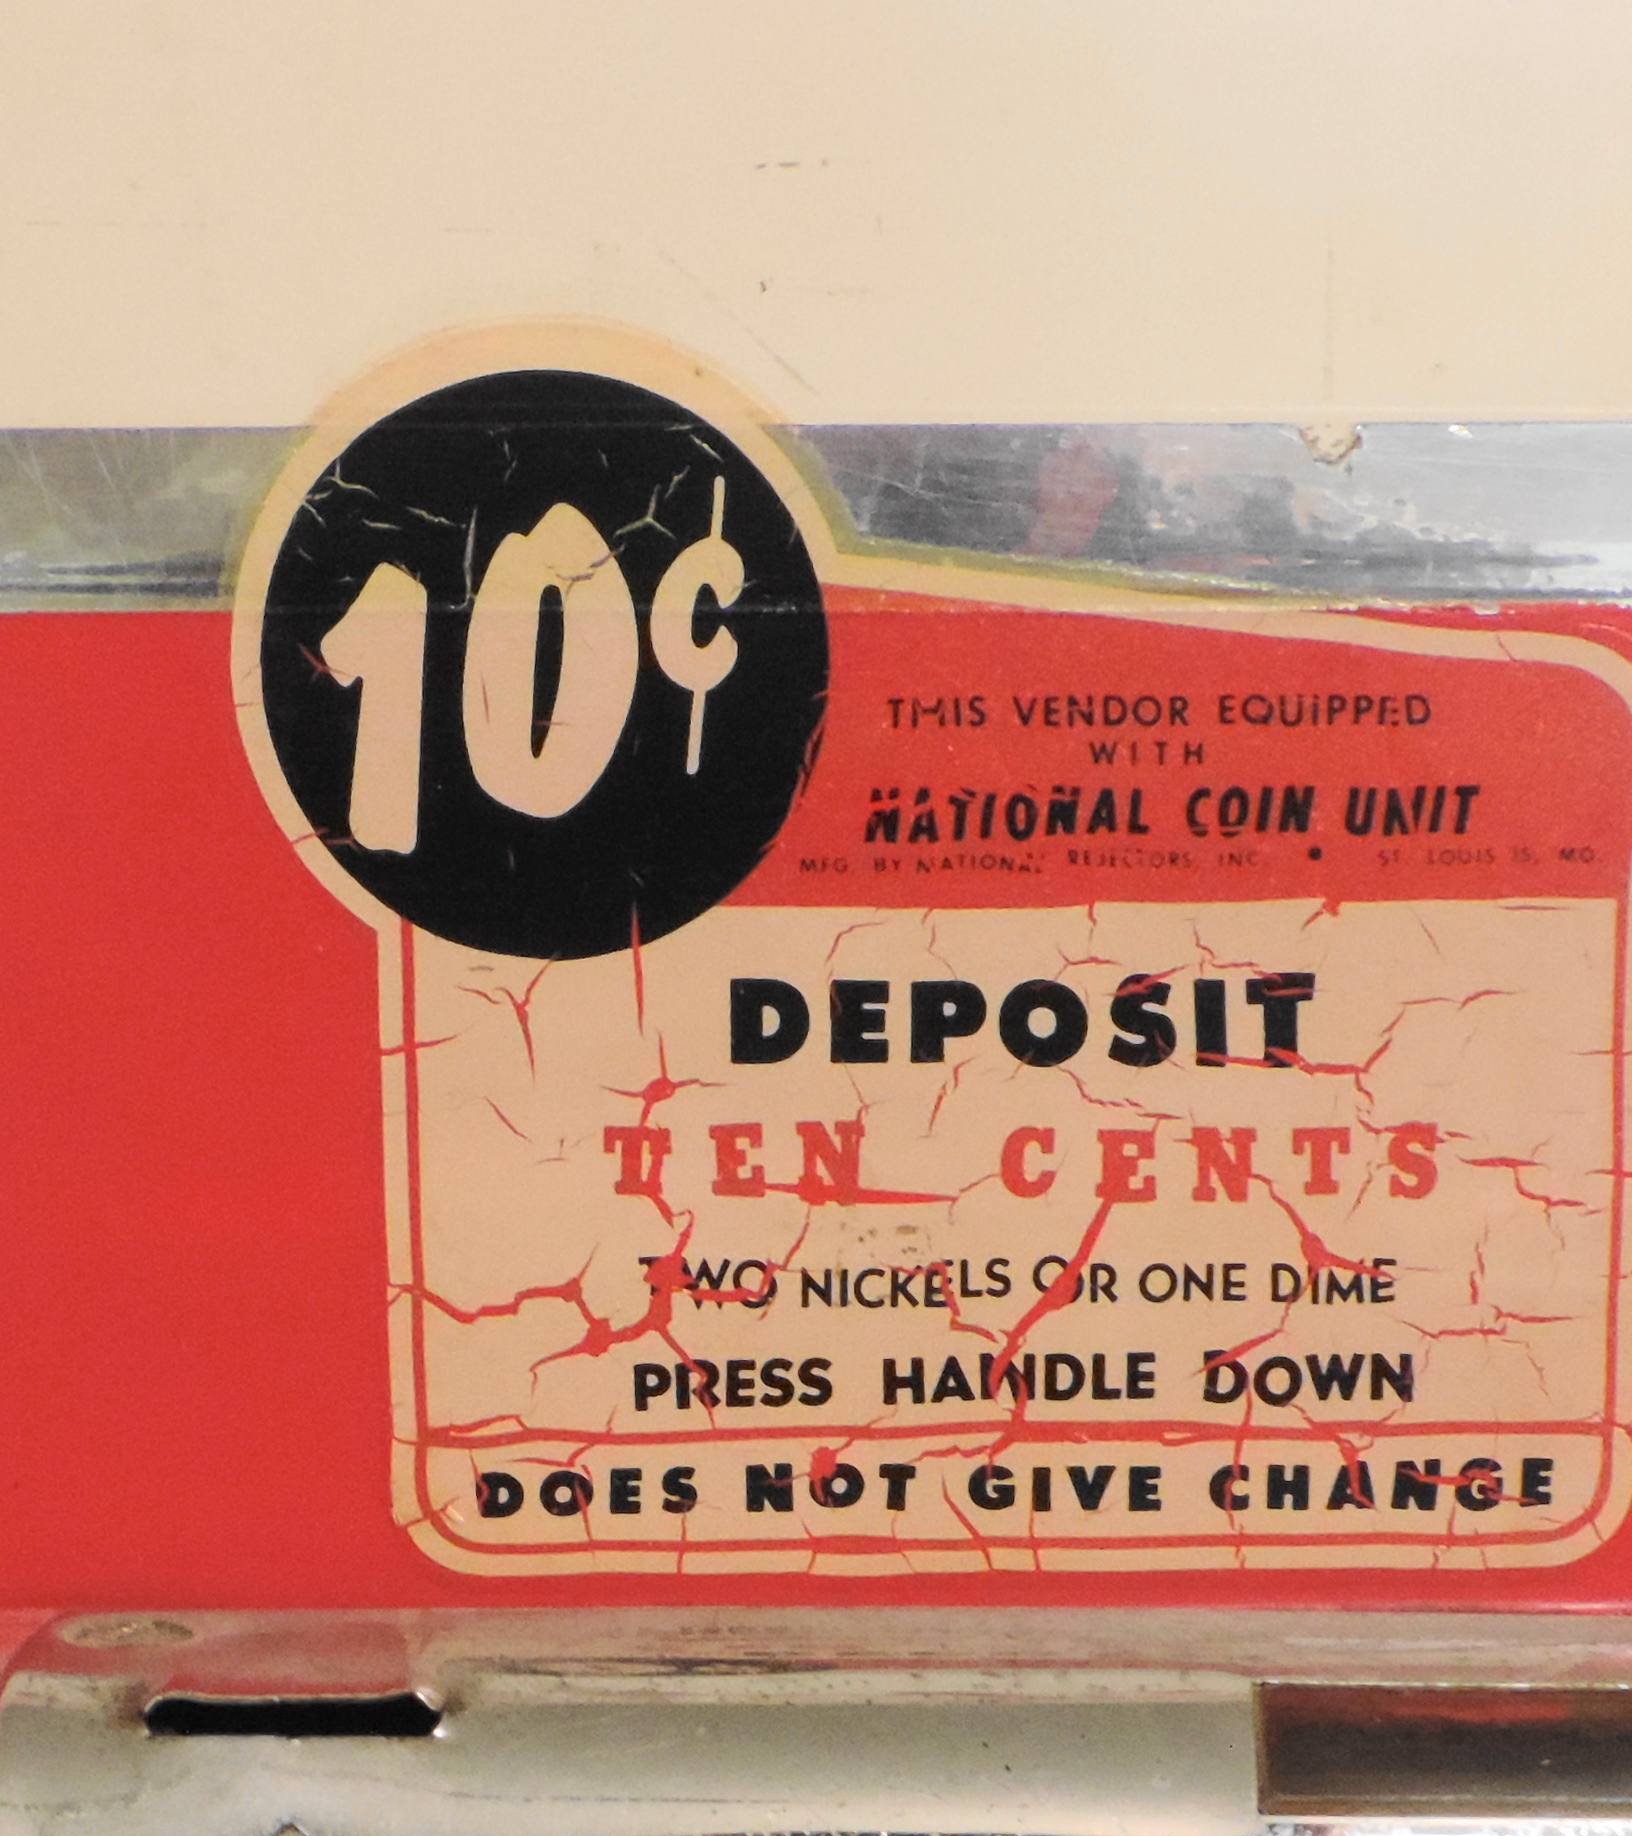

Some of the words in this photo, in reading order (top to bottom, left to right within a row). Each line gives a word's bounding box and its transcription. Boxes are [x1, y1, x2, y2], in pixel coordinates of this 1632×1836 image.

[320, 475, 745, 854] 10¢
[887, 695, 986, 729] THIS
[1013, 694, 1190, 727] VENDOR
[1218, 693, 1433, 728] EQUIPPED
[1089, 740, 1205, 766] WITH
[863, 784, 1150, 844] NATIONAL
[1185, 785, 1316, 837] COIN
[1343, 784, 1482, 836] UNIT
[873, 855, 902, 874] BY
[730, 972, 1317, 1070] DEPOSIT
[602, 1118, 868, 1205] TEN
[998, 1120, 1441, 1202] CENTS
[800, 1256, 1012, 1309] NICKELS
[1032, 1254, 1119, 1304] OR
[1138, 1262, 1248, 1304] ONE
[1270, 1256, 1398, 1306] DIME
[633, 1356, 834, 1412] PRESS
[881, 1351, 1157, 1406] HANDLE
[1202, 1348, 1415, 1409] DOWN
[480, 1458, 699, 1518] DOES
[745, 1459, 919, 1514] NOT
[983, 1458, 1164, 1514] GIVE
[1208, 1454, 1556, 1513] CHANGE
